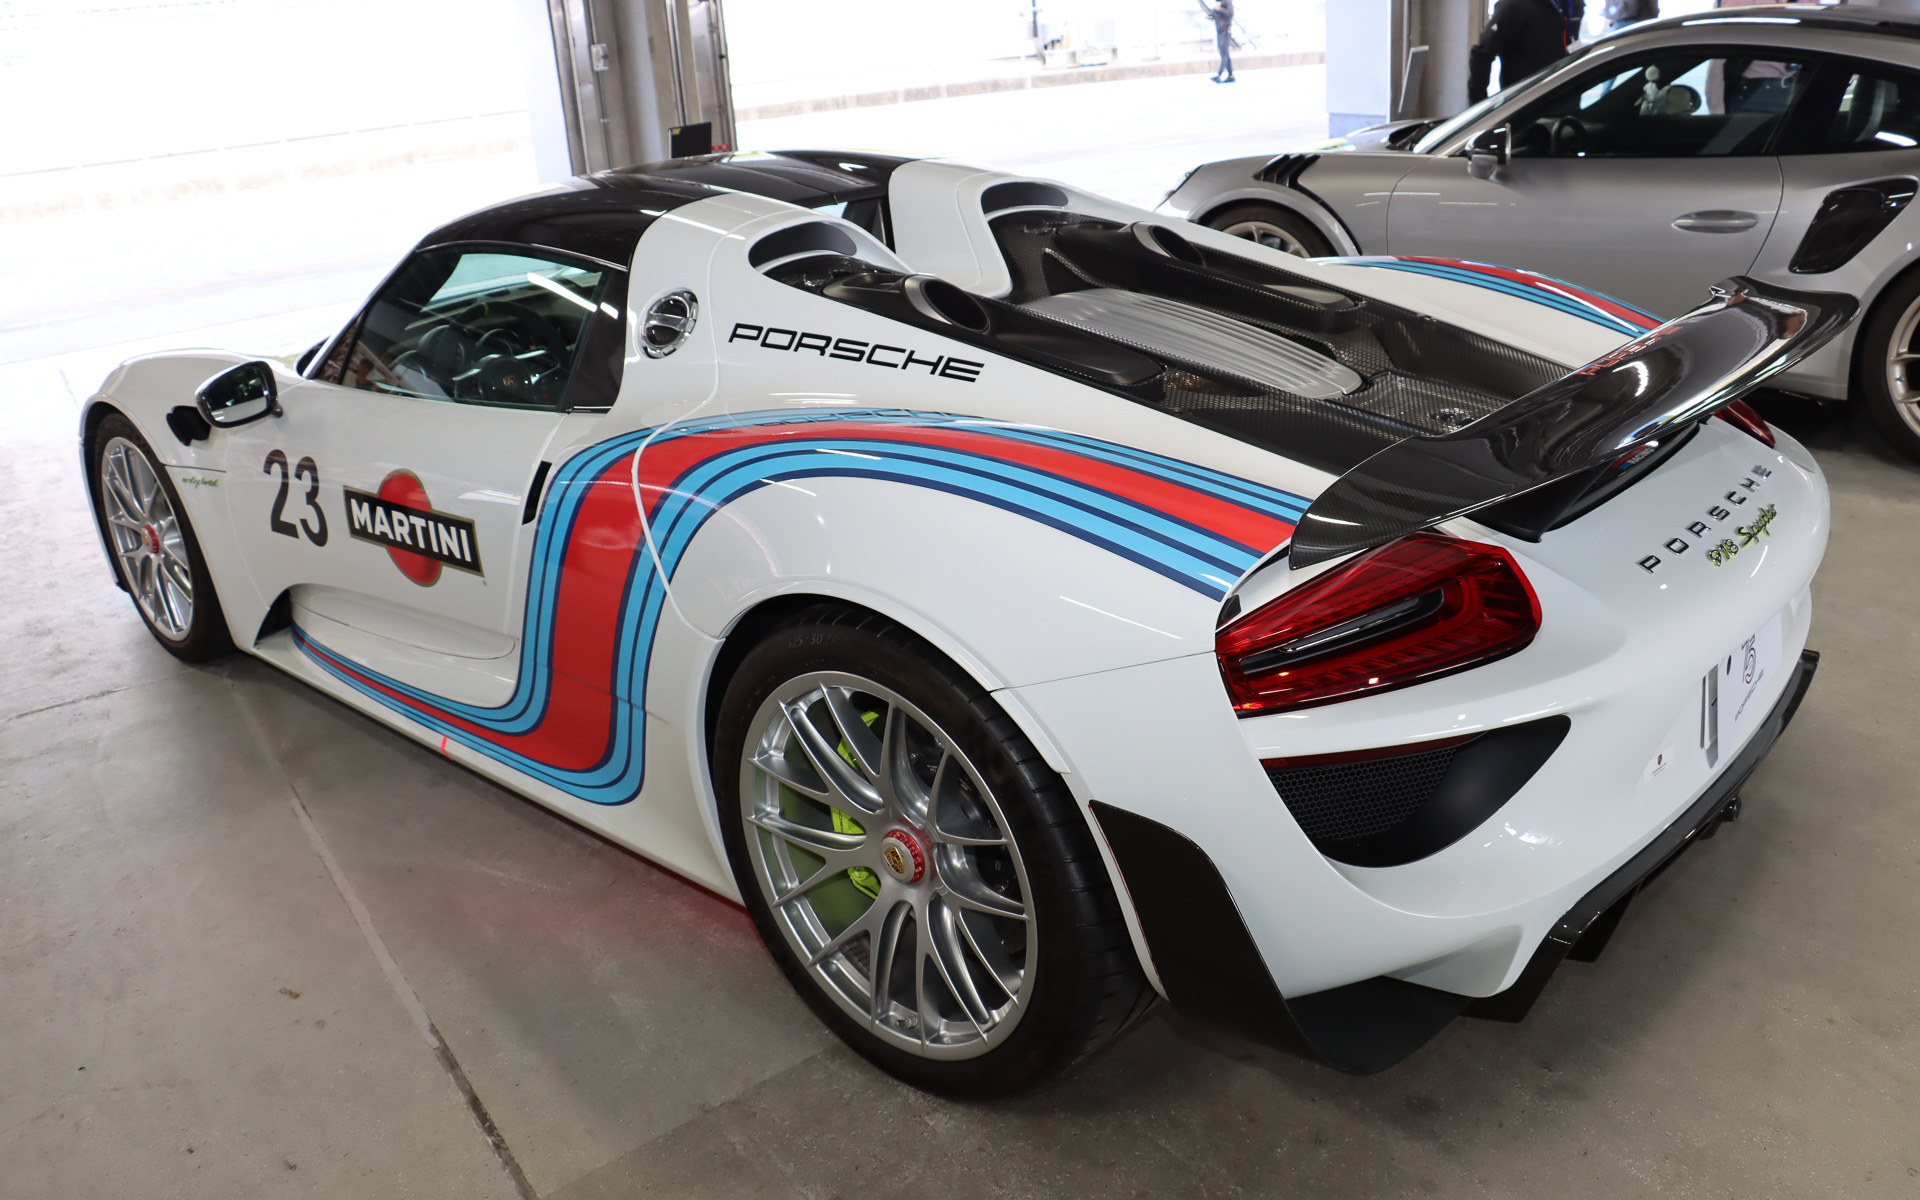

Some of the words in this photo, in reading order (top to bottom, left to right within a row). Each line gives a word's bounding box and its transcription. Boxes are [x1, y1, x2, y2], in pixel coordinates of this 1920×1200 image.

[728, 323, 985, 383] PORSCHE
[263, 449, 328, 547] 23
[351, 498, 473, 562] MARTINI
[1636, 464, 1772, 574] PORSCHE
[1705, 538, 1739, 568] 918
[1734, 503, 1778, 549] Spyder
